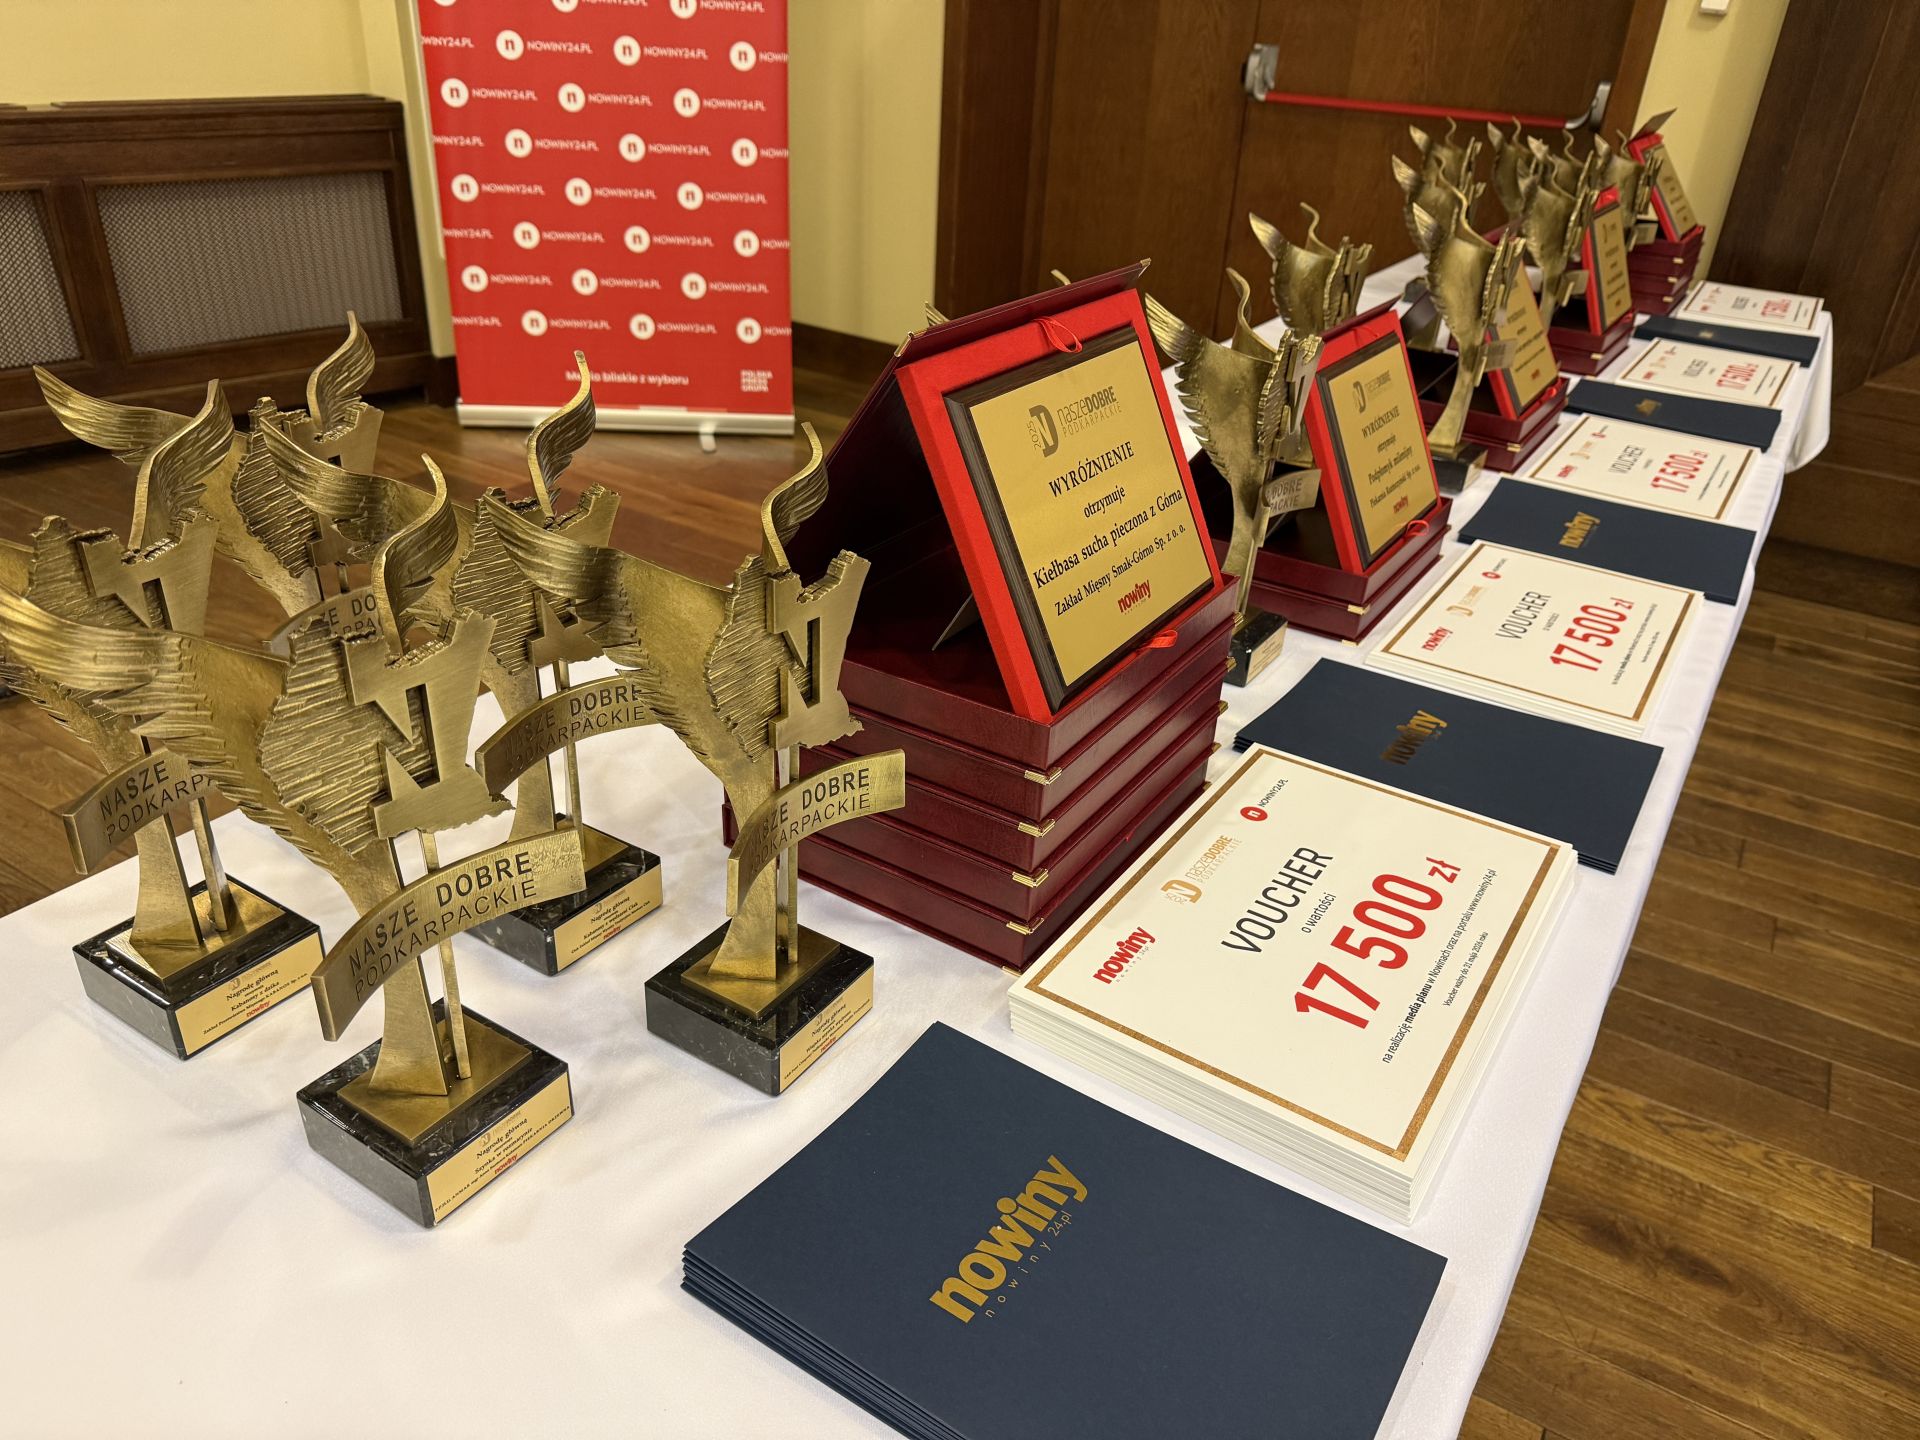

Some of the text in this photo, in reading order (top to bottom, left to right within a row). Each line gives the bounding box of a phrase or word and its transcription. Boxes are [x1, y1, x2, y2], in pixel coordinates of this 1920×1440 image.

[1062, 401, 1123, 438] PODKARPACKIE
[1048, 441, 1135, 498] WYRÓŻNIENIE
[1651, 476, 1690, 494] 17
[1658, 453, 1705, 480] 500
[1083, 485, 1126, 519] otrzymuje
[1032, 488, 1184, 589] Kiełbasa sucha pieczona z Górna
[1054, 523, 1187, 617] Zakład Mięsny Smak-Górno Sp. z o. o.
[1117, 578, 1152, 614] nowiny
[1495, 590, 1552, 640] VOUCHER
[1609, 596, 1635, 611] zł
[1563, 604, 1628, 648] 500
[1550, 643, 1603, 672] 17
[100, 759, 170, 822] NASZE
[802, 767, 870, 810] DOBRE
[1257, 778, 1289, 808] NOWINY24.PL
[349, 851, 534, 977] NASZE DOBRE
[1221, 847, 1334, 953] VOUCHER
[1301, 891, 1337, 934] o wartości
[355, 878, 538, 1002] PODKARPACKIE
[1092, 926, 1156, 984] nowiny
[1294, 856, 1462, 1030] 17 500 zł
[226, 982, 254, 1002] Nagrodę
[255, 967, 279, 987] główną
[1382, 868, 1497, 1064] na realizację media planu w Nowinach oraz na portalu www.nowiny24.pl
[231, 993, 259, 1013] Kabanosy
[246, 999, 271, 1018] nowiny
[1442, 987, 1459, 1007] Voucher
[475, 1135, 505, 1160] Nagrodę
[504, 1117, 529, 1142] główną
[494, 1153, 518, 1175] nowiny
[928, 1154, 1088, 1324] nowiny
